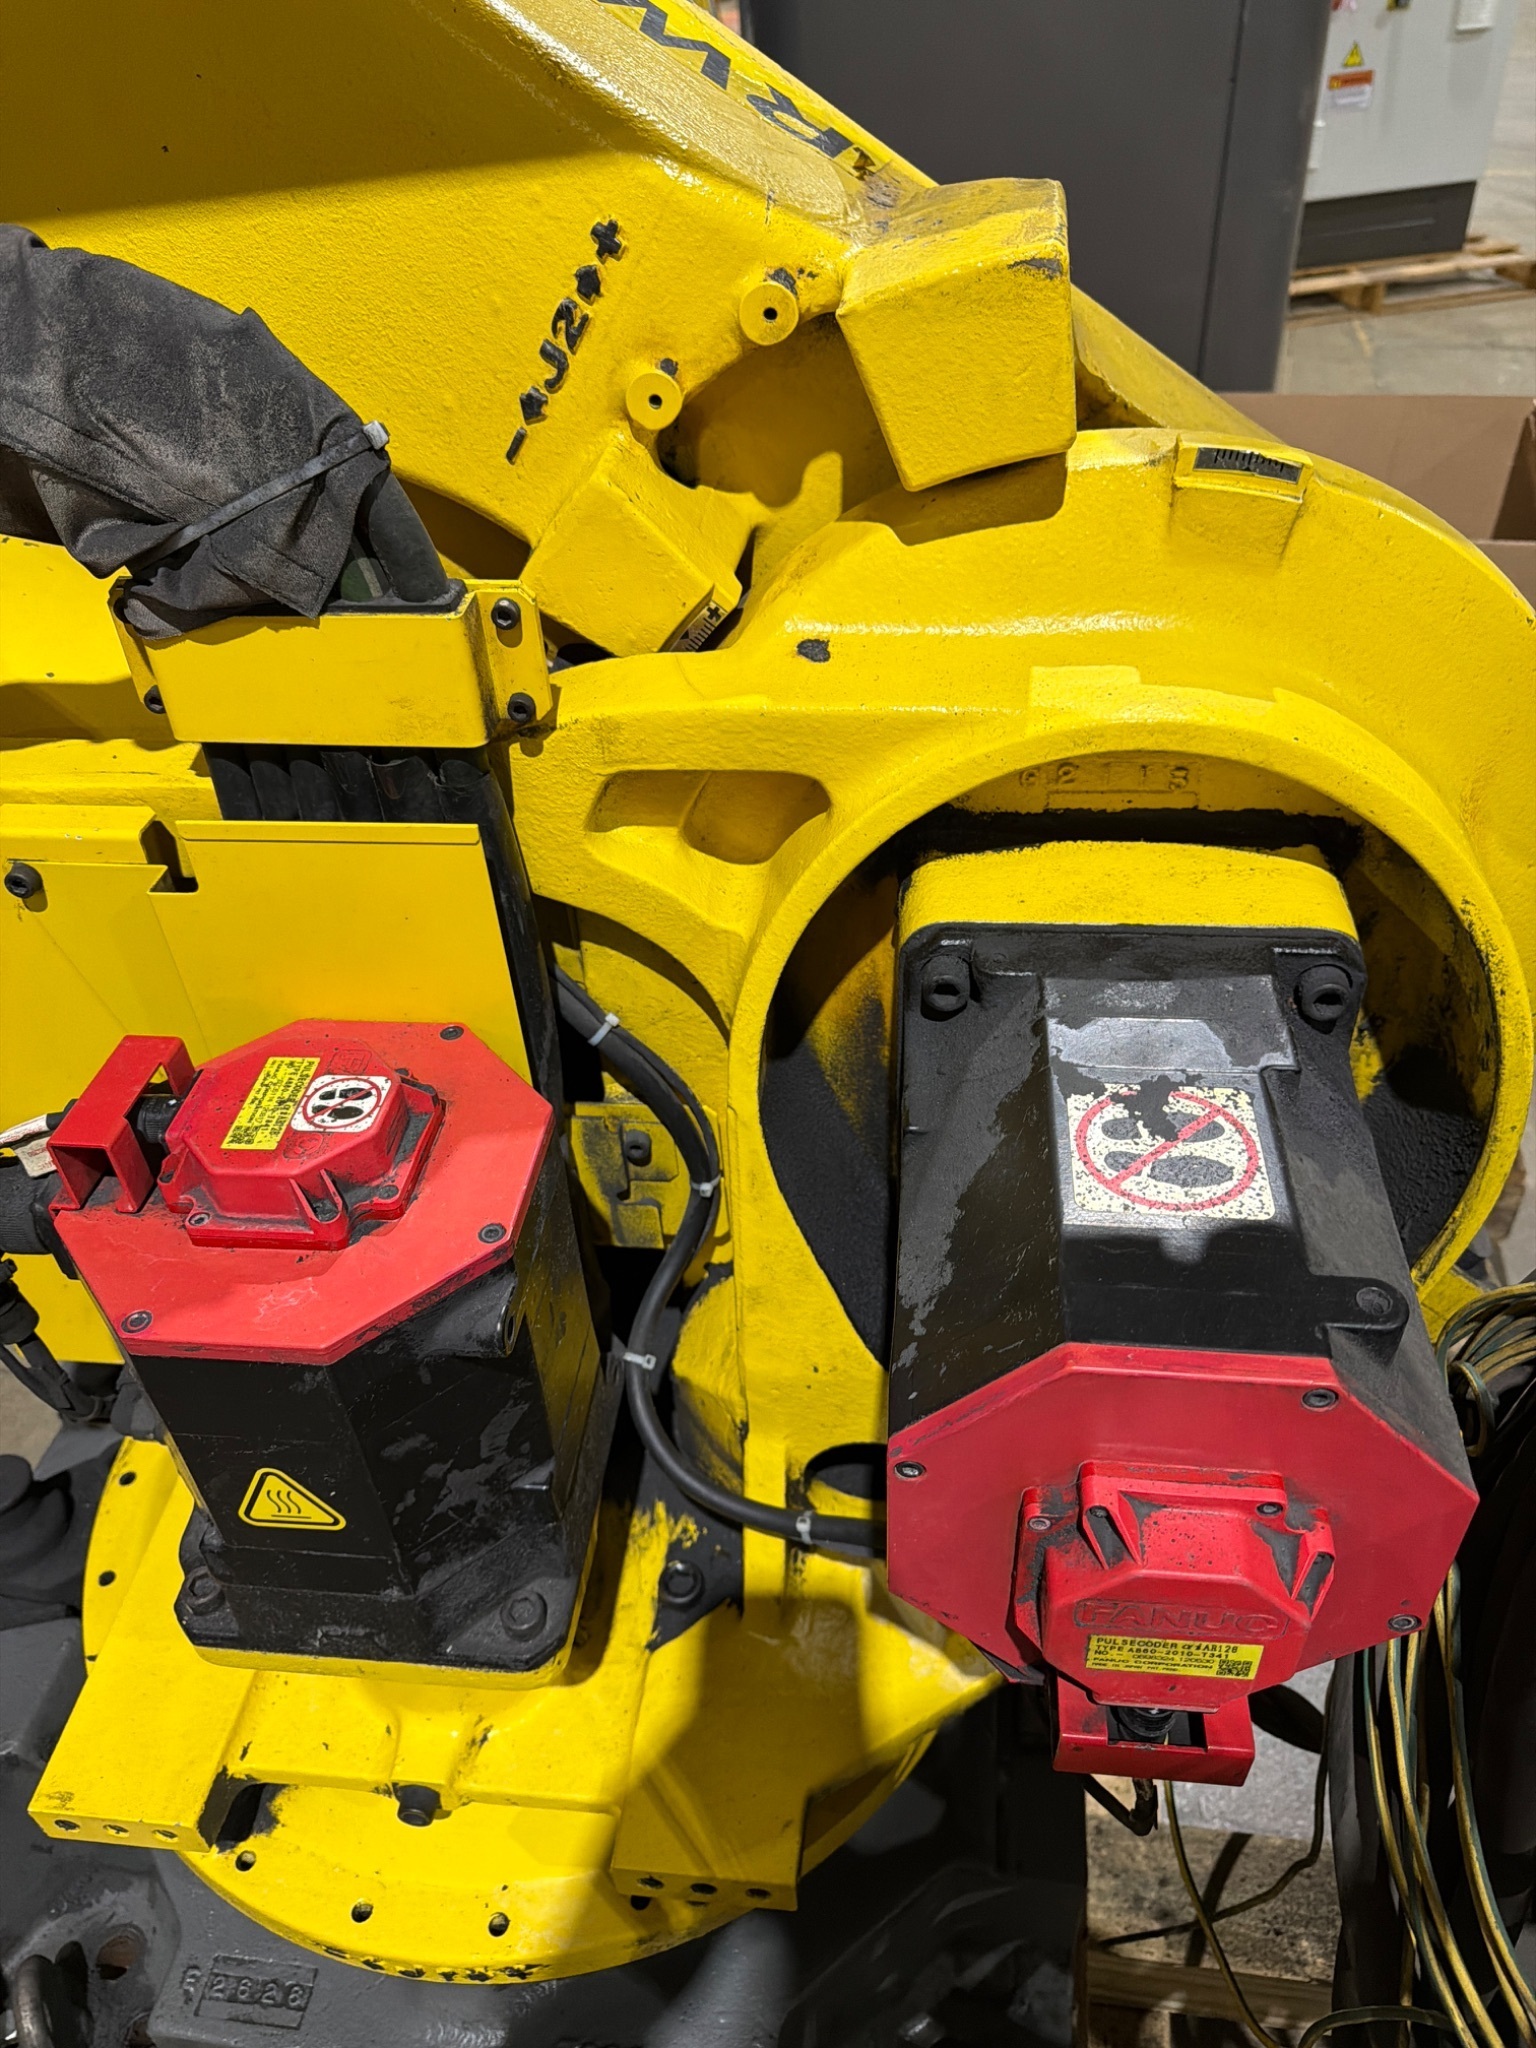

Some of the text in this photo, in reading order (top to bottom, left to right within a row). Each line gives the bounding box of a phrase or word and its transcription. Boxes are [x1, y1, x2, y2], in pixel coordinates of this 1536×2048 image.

[539, 298, 590, 391] J2
[1081, 1602, 1279, 1632] FANUC
[1095, 1644, 1125, 1652] TYPE
[1096, 1637, 1179, 1650] PULSECODER
[1093, 1656, 1214, 1669] FANUC CORPORATION
